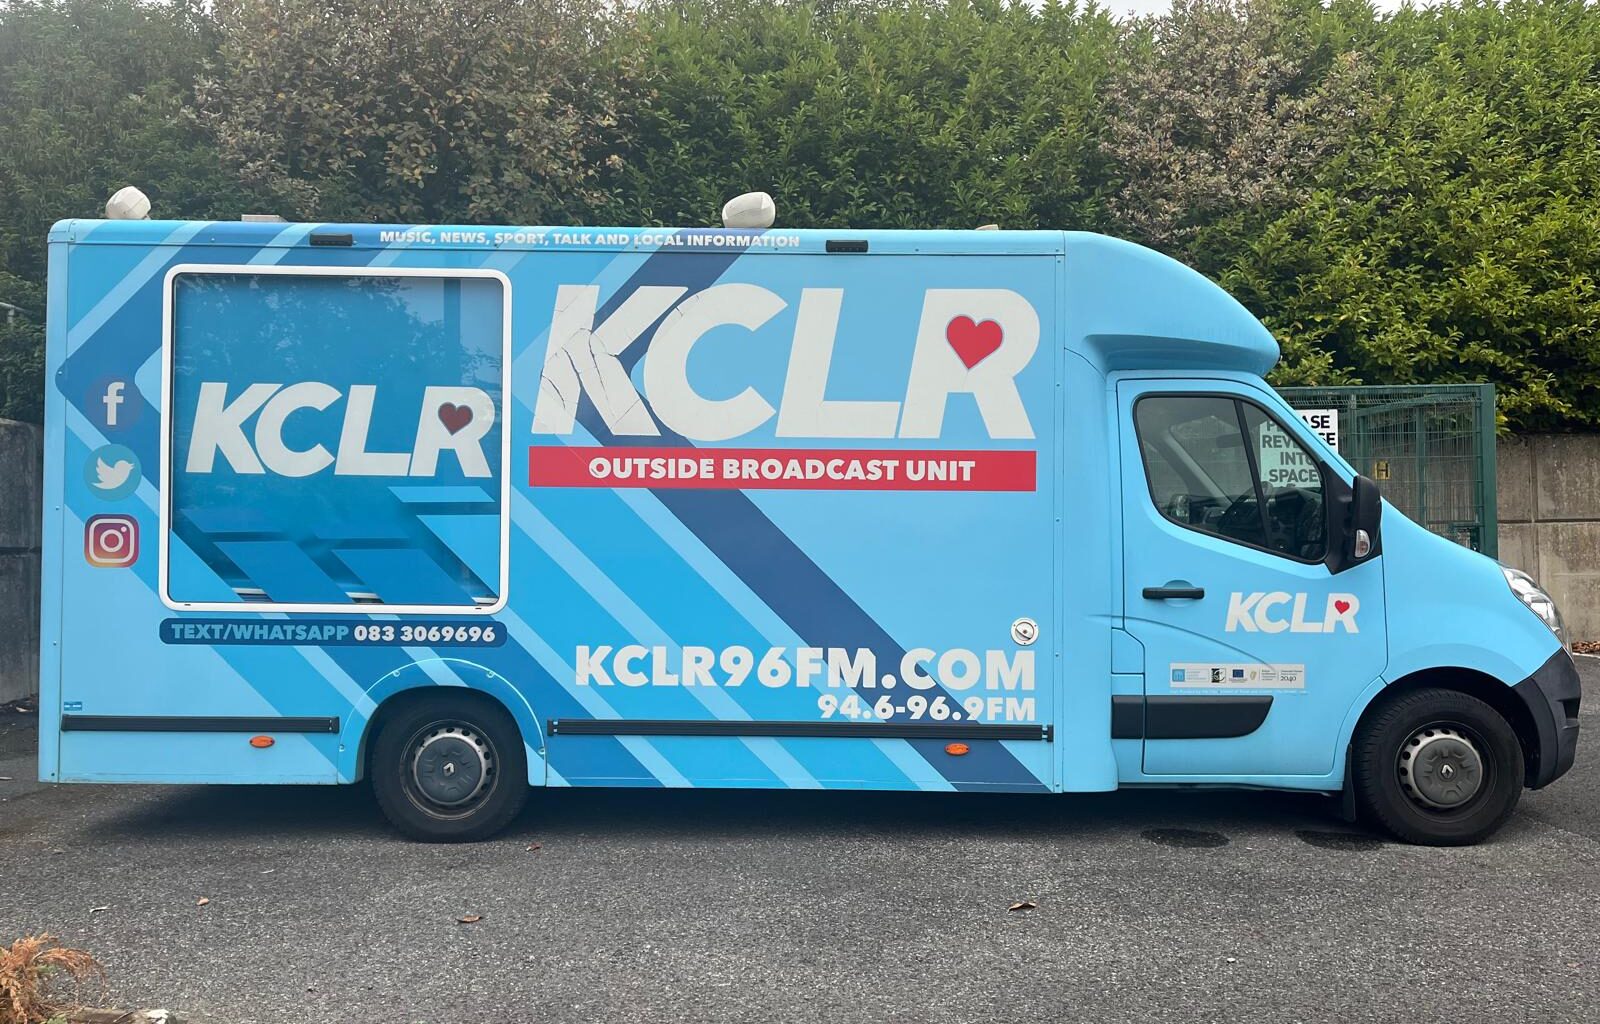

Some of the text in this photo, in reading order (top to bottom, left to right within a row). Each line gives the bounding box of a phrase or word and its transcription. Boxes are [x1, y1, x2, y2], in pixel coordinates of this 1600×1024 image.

[380, 231, 800, 247] MUSIC, NEWS, SPORT, TALK AND LOCAL INFORMATION
[531, 283, 1041, 442] KCLR
[185, 381, 496, 478] KCLR
[589, 457, 976, 482] OUTSIDE BROADCAST UNIT
[1225, 592, 1360, 634] KCLR
[171, 624, 496, 643] TEXT/WHATSAPP 083 3069696
[575, 645, 1036, 690] KCLR96FM.COM
[817, 694, 1036, 722] 94.6-96.9FM
